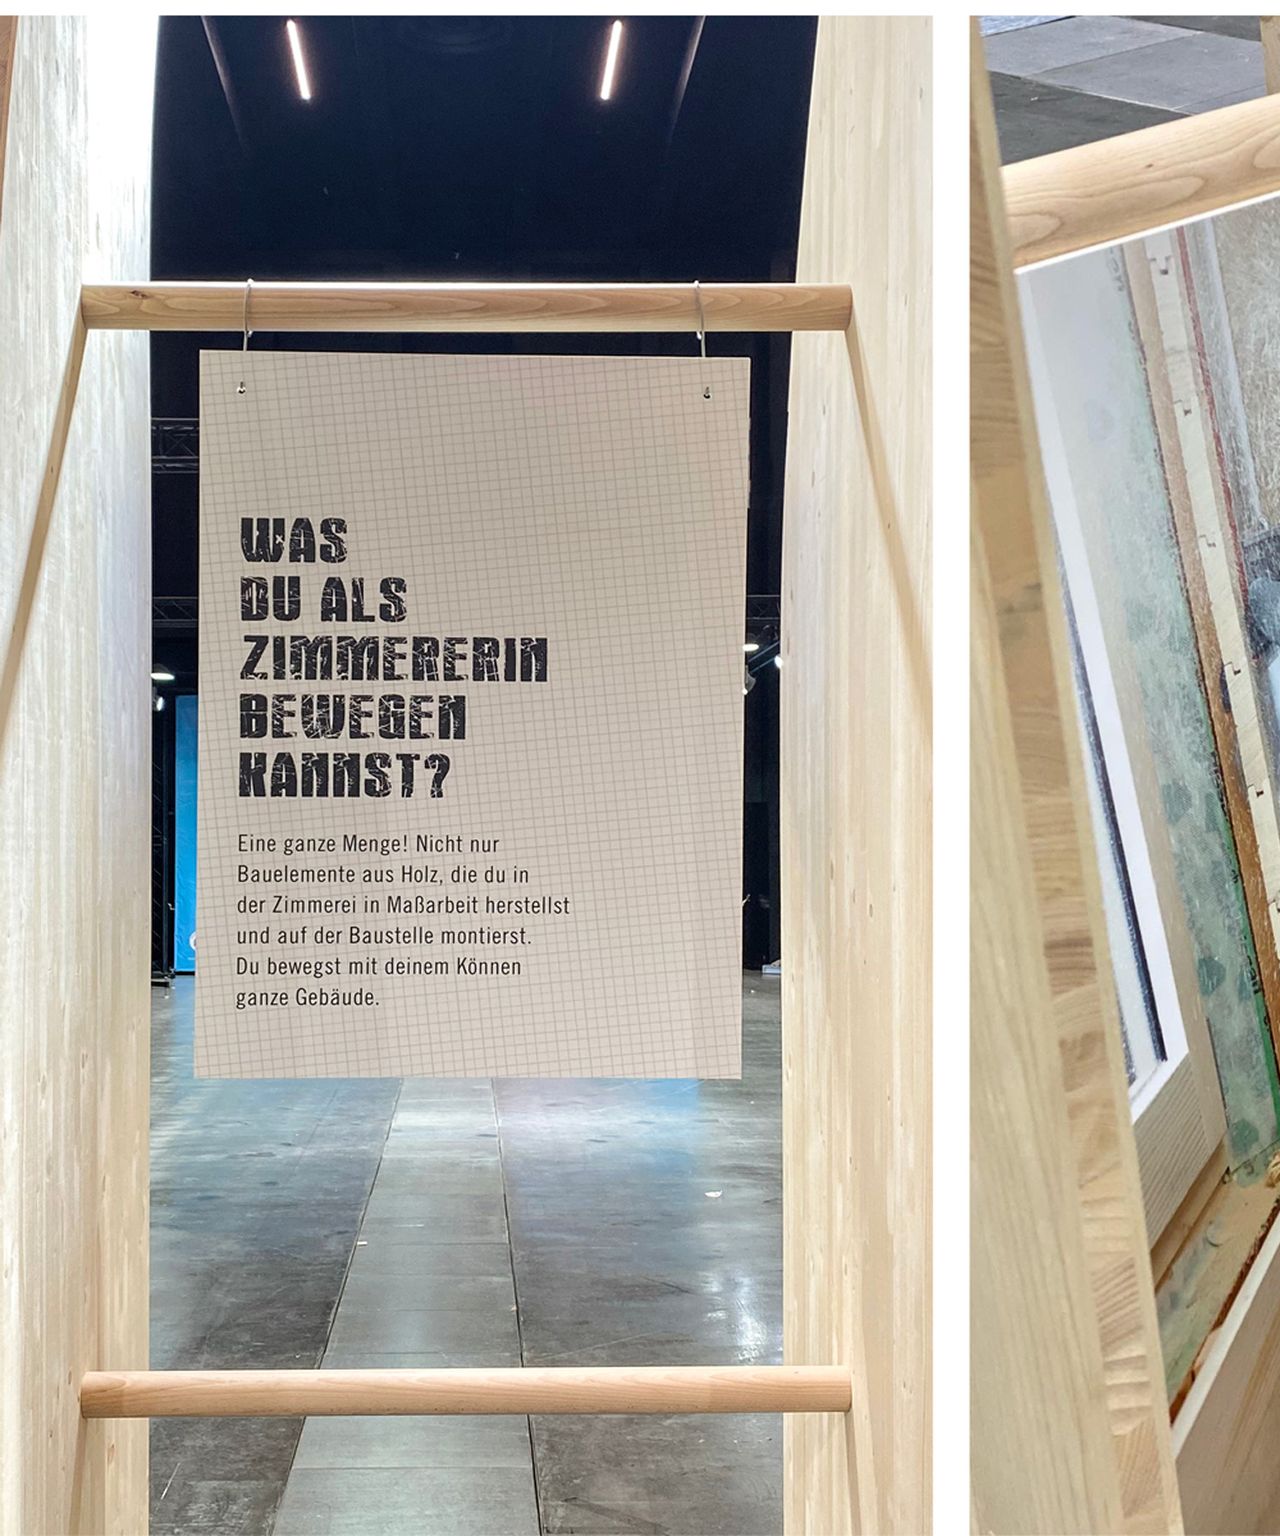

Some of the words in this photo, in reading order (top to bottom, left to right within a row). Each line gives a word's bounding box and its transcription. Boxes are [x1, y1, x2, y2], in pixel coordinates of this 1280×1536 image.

[240, 517, 348, 564] WAS
[240, 576, 301, 622] DU
[320, 576, 407, 622] ALS
[240, 635, 548, 683] ZIMMERERIN
[239, 694, 466, 740] BEWEGEN
[239, 752, 451, 798] KANNST?
[238, 834, 276, 853] Eine
[283, 838, 336, 856] ganze
[343, 835, 408, 856] Menge!
[416, 835, 463, 853] Nicht
[470, 838, 500, 853] nur
[238, 865, 356, 884] Bauelemente
[362, 869, 395, 884] aus
[401, 866, 444, 886] Holz,
[451, 866, 478, 884] die
[484, 866, 506, 884] du
[513, 866, 530, 884] in
[237, 896, 265, 914] der
[272, 896, 357, 914] Zimmerei
[364, 896, 380, 914] in
[387, 895, 478, 914] Maßarbeit
[485, 896, 570, 914] herstellst
[237, 926, 270, 945] und
[277, 926, 307, 945] auf
[314, 926, 342, 945] der
[349, 926, 434, 945] Baustelle
[441, 926, 532, 945] montierst.
[236, 957, 259, 975] Du
[268, 957, 341, 978] bewegst
[348, 957, 377, 975] mit
[384, 957, 449, 975] deinem
[457, 957, 522, 975] Können
[236, 991, 289, 1009] ganze
[295, 987, 380, 1006] Gebäude.
